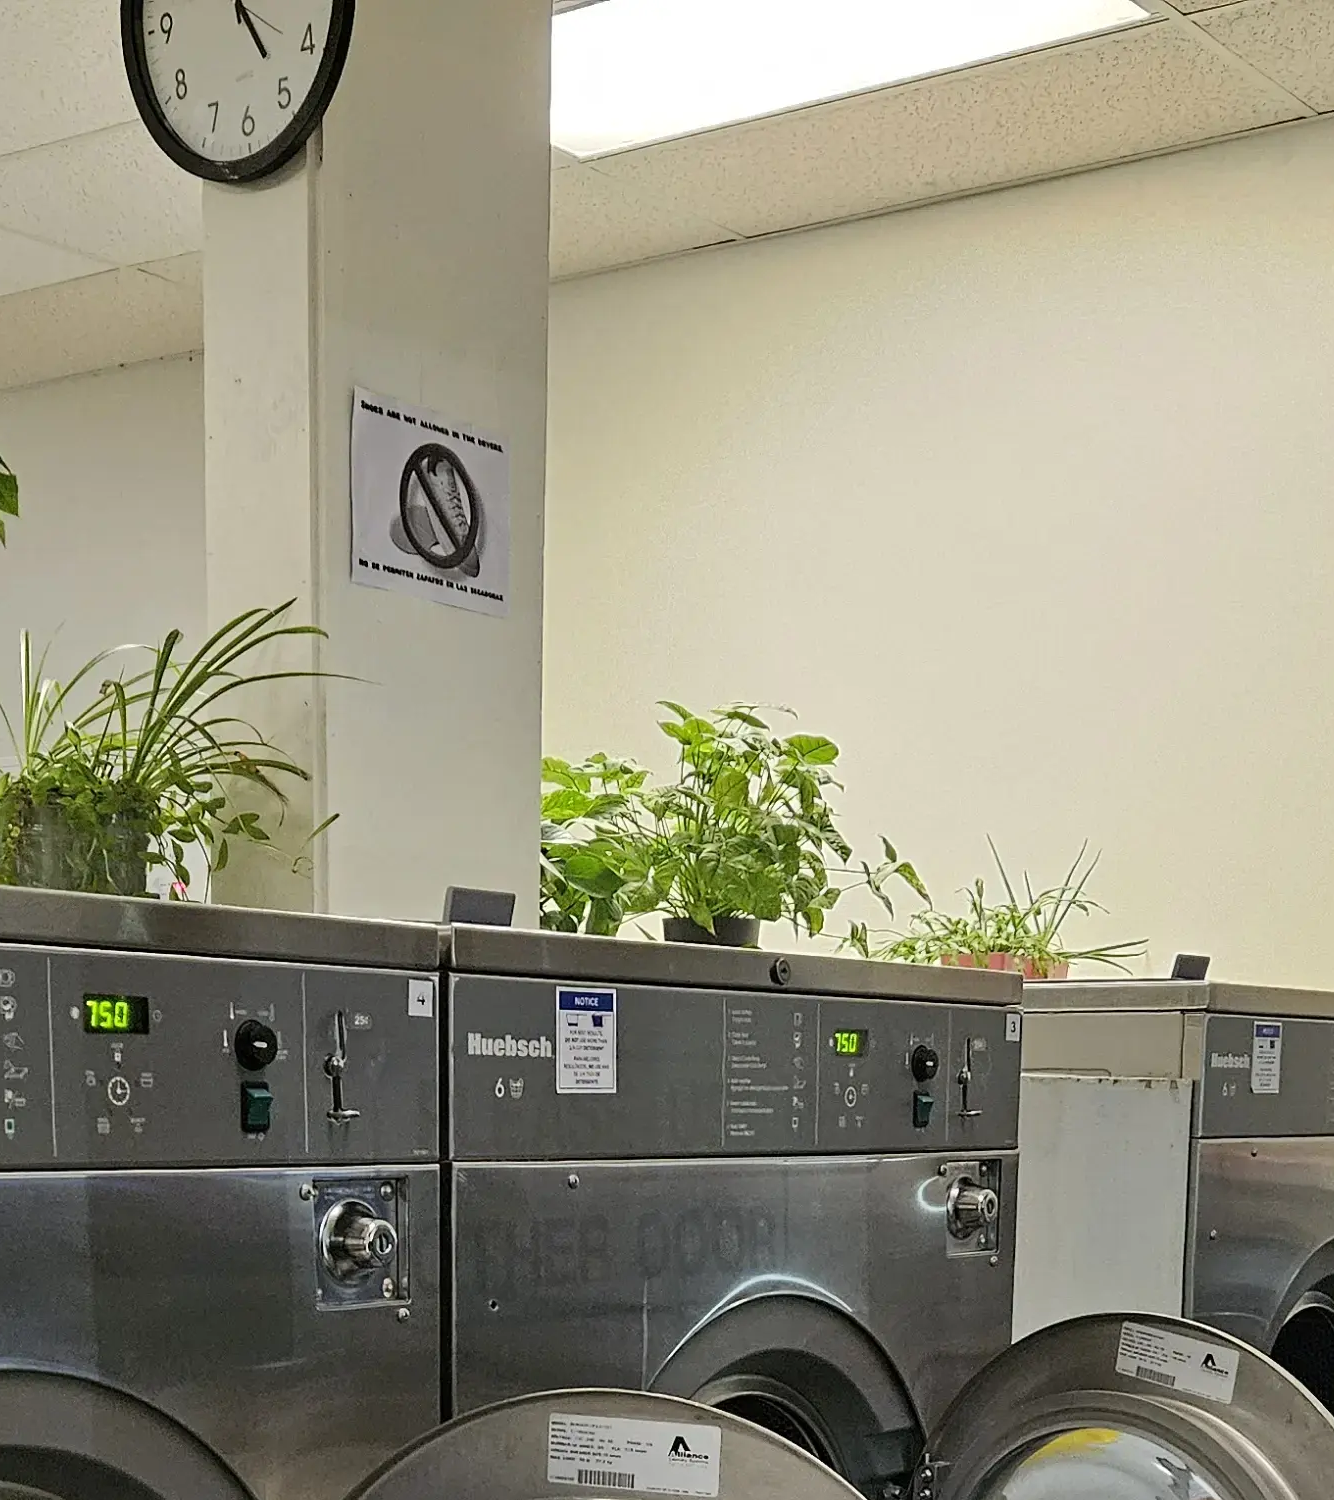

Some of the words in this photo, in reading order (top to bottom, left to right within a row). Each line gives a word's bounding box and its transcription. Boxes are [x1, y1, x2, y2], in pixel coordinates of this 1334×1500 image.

[160, 12, 173, 44] 9
[300, 22, 315, 55] 4
[175, 68, 187, 100] 8
[277, 76, 291, 109] 5
[207, 100, 219, 133] 7
[241, 105, 255, 136] 6
[386, 409, 401, 421] ARE
[403, 414, 417, 426] NOT
[417, 995, 426, 1006] 4
[575, 997, 599, 1007] NOTICE
[1011, 1021, 1017, 1033] 3
[467, 1032, 553, 1058] Huebsch
[495, 1077, 505, 1098] 6
